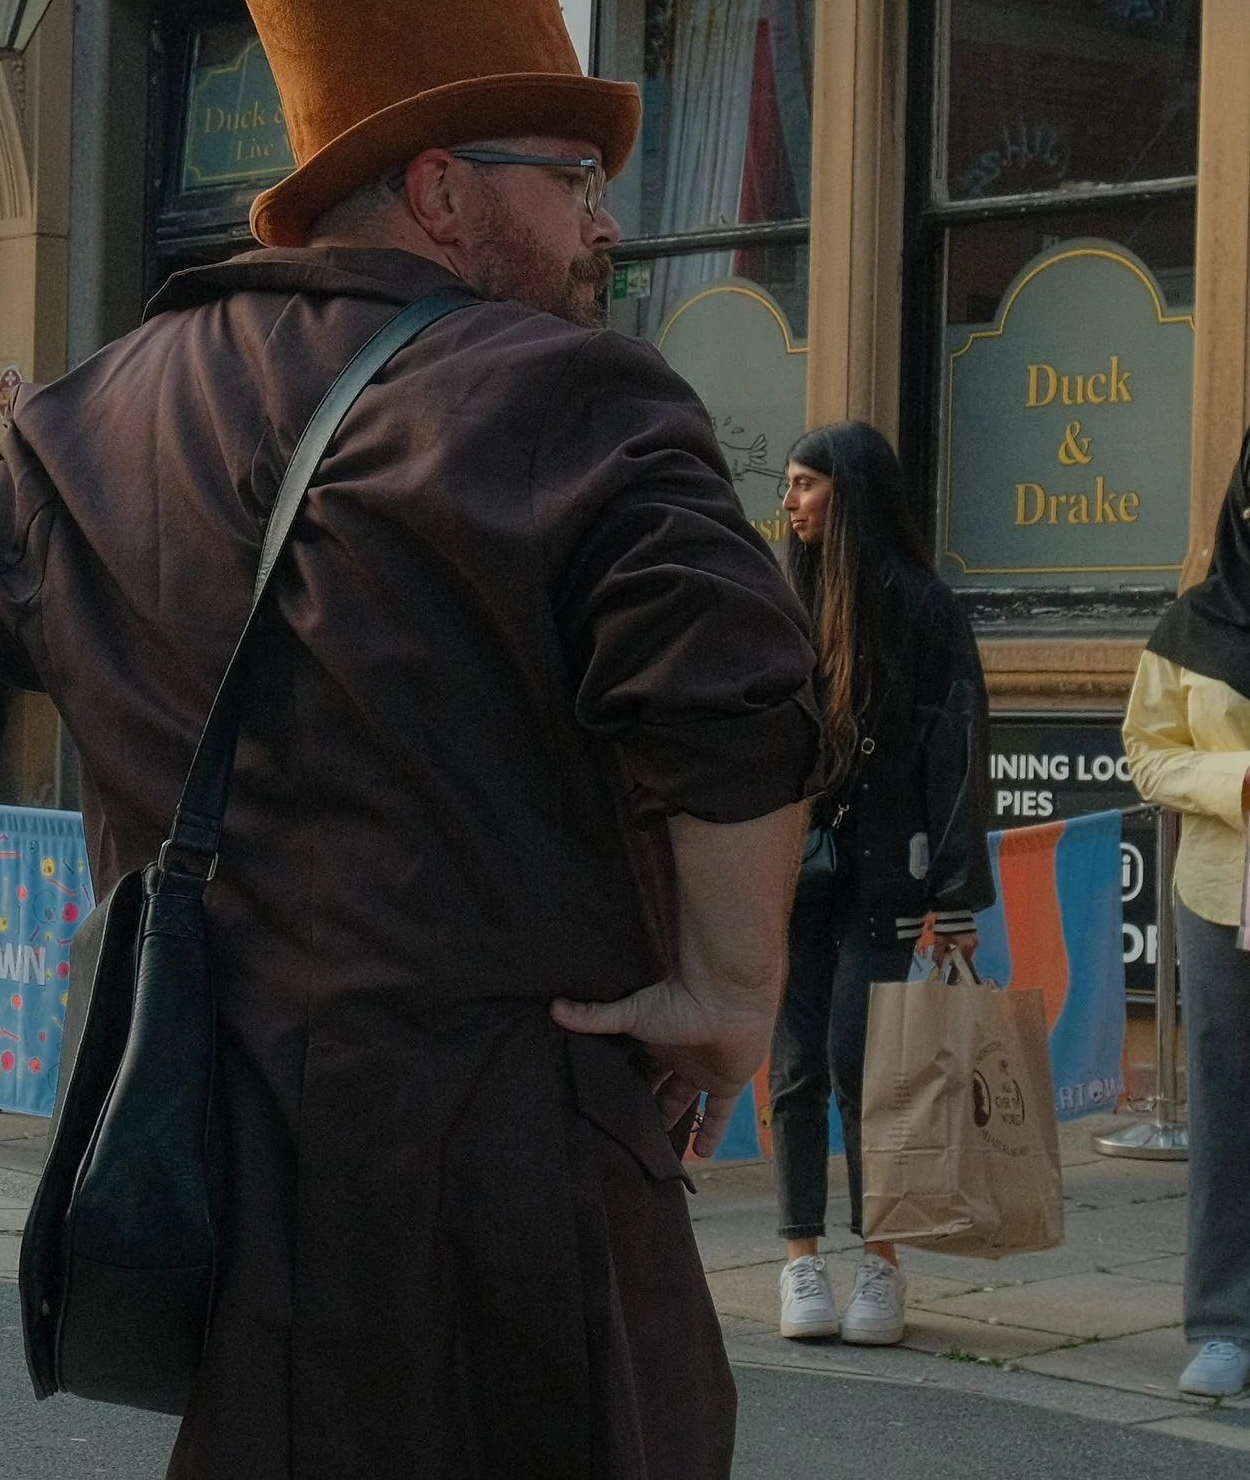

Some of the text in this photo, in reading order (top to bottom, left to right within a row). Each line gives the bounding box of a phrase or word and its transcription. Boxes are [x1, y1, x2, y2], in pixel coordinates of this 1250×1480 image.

[205, 100, 266, 133] Duck
[1025, 355, 1134, 408] Duck
[1057, 420, 1094, 465] &
[1013, 474, 1141, 527] Drake
[990, 753, 1070, 781] INING
[996, 790, 1054, 817] PIES
